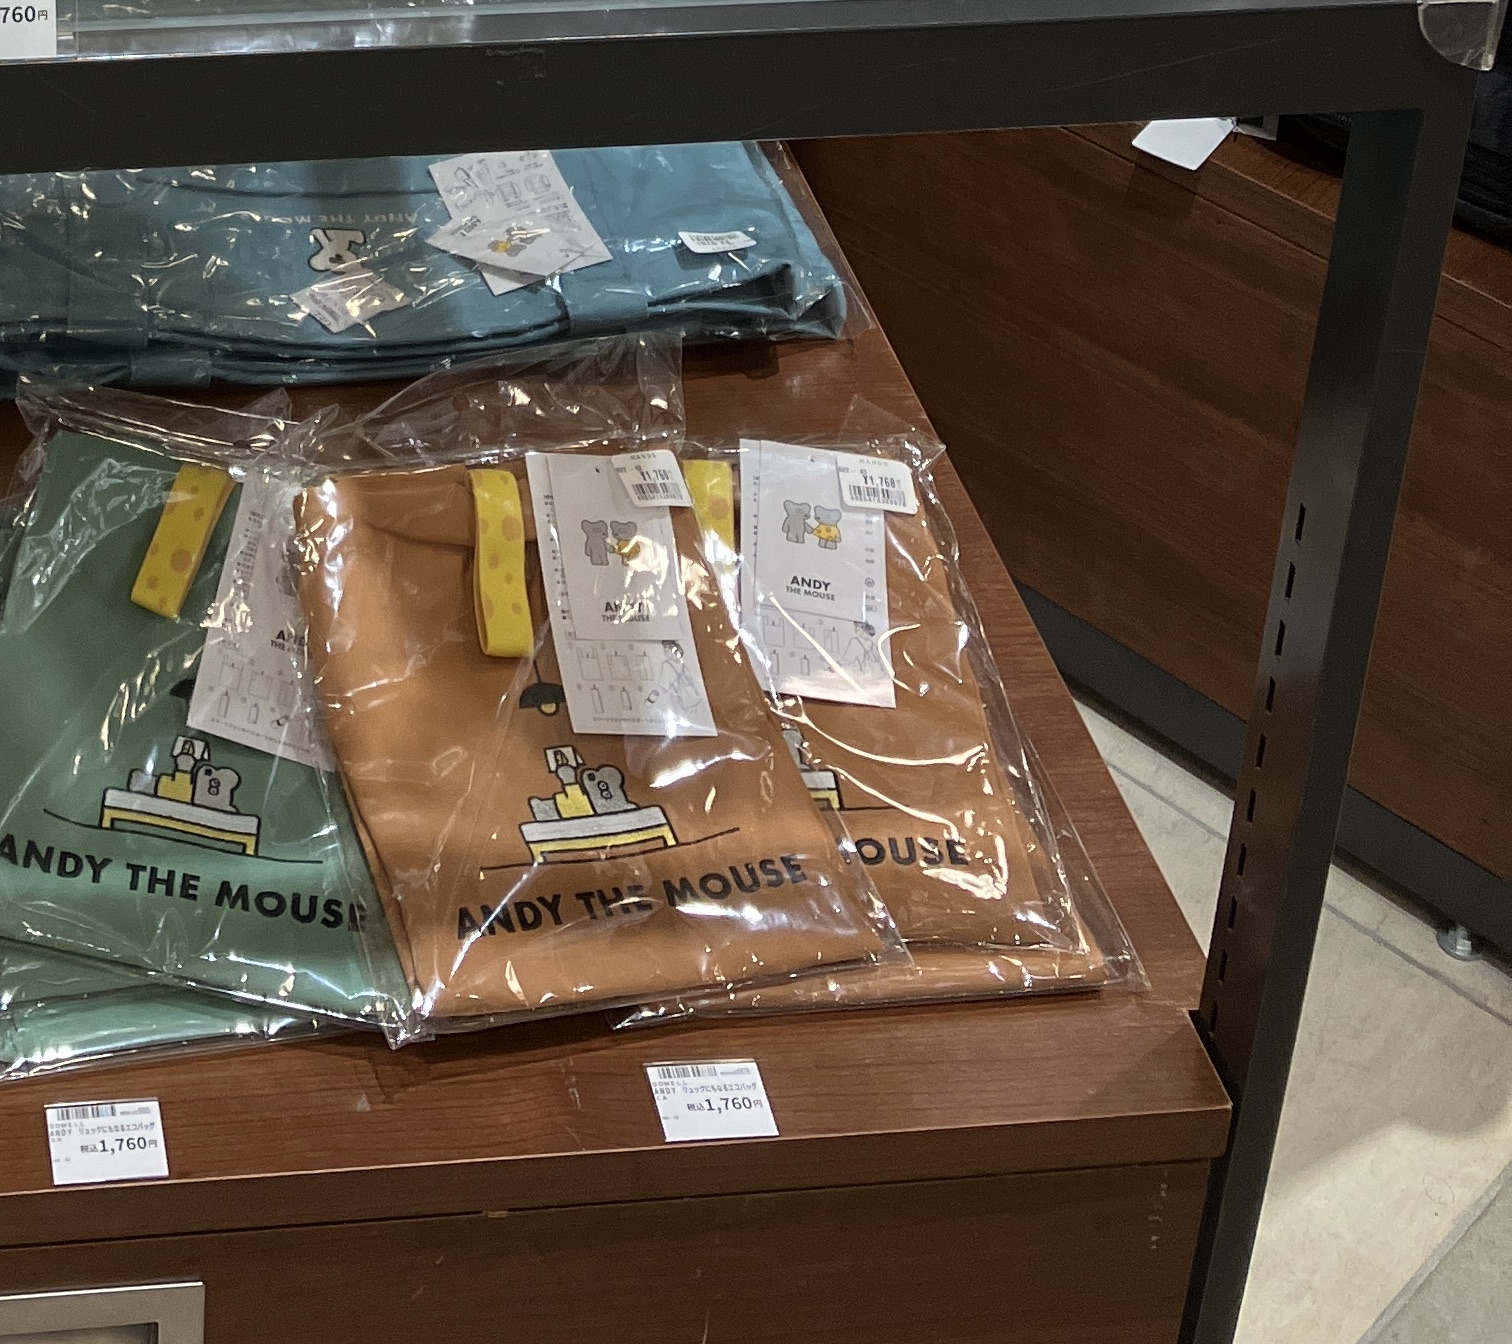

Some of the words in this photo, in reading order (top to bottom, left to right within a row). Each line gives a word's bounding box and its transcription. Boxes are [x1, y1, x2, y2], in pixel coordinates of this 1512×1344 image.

[786, 586, 802, 595] THE
[804, 590, 835, 601] MOUSE
[791, 575, 831, 591] ANDY
[842, 837, 972, 866] OUSE
[125, 862, 200, 902] THE
[214, 880, 367, 933] MOUSE
[456, 894, 563, 940] ANDY
[575, 884, 648, 921] THE
[662, 853, 808, 908] MOUSE
